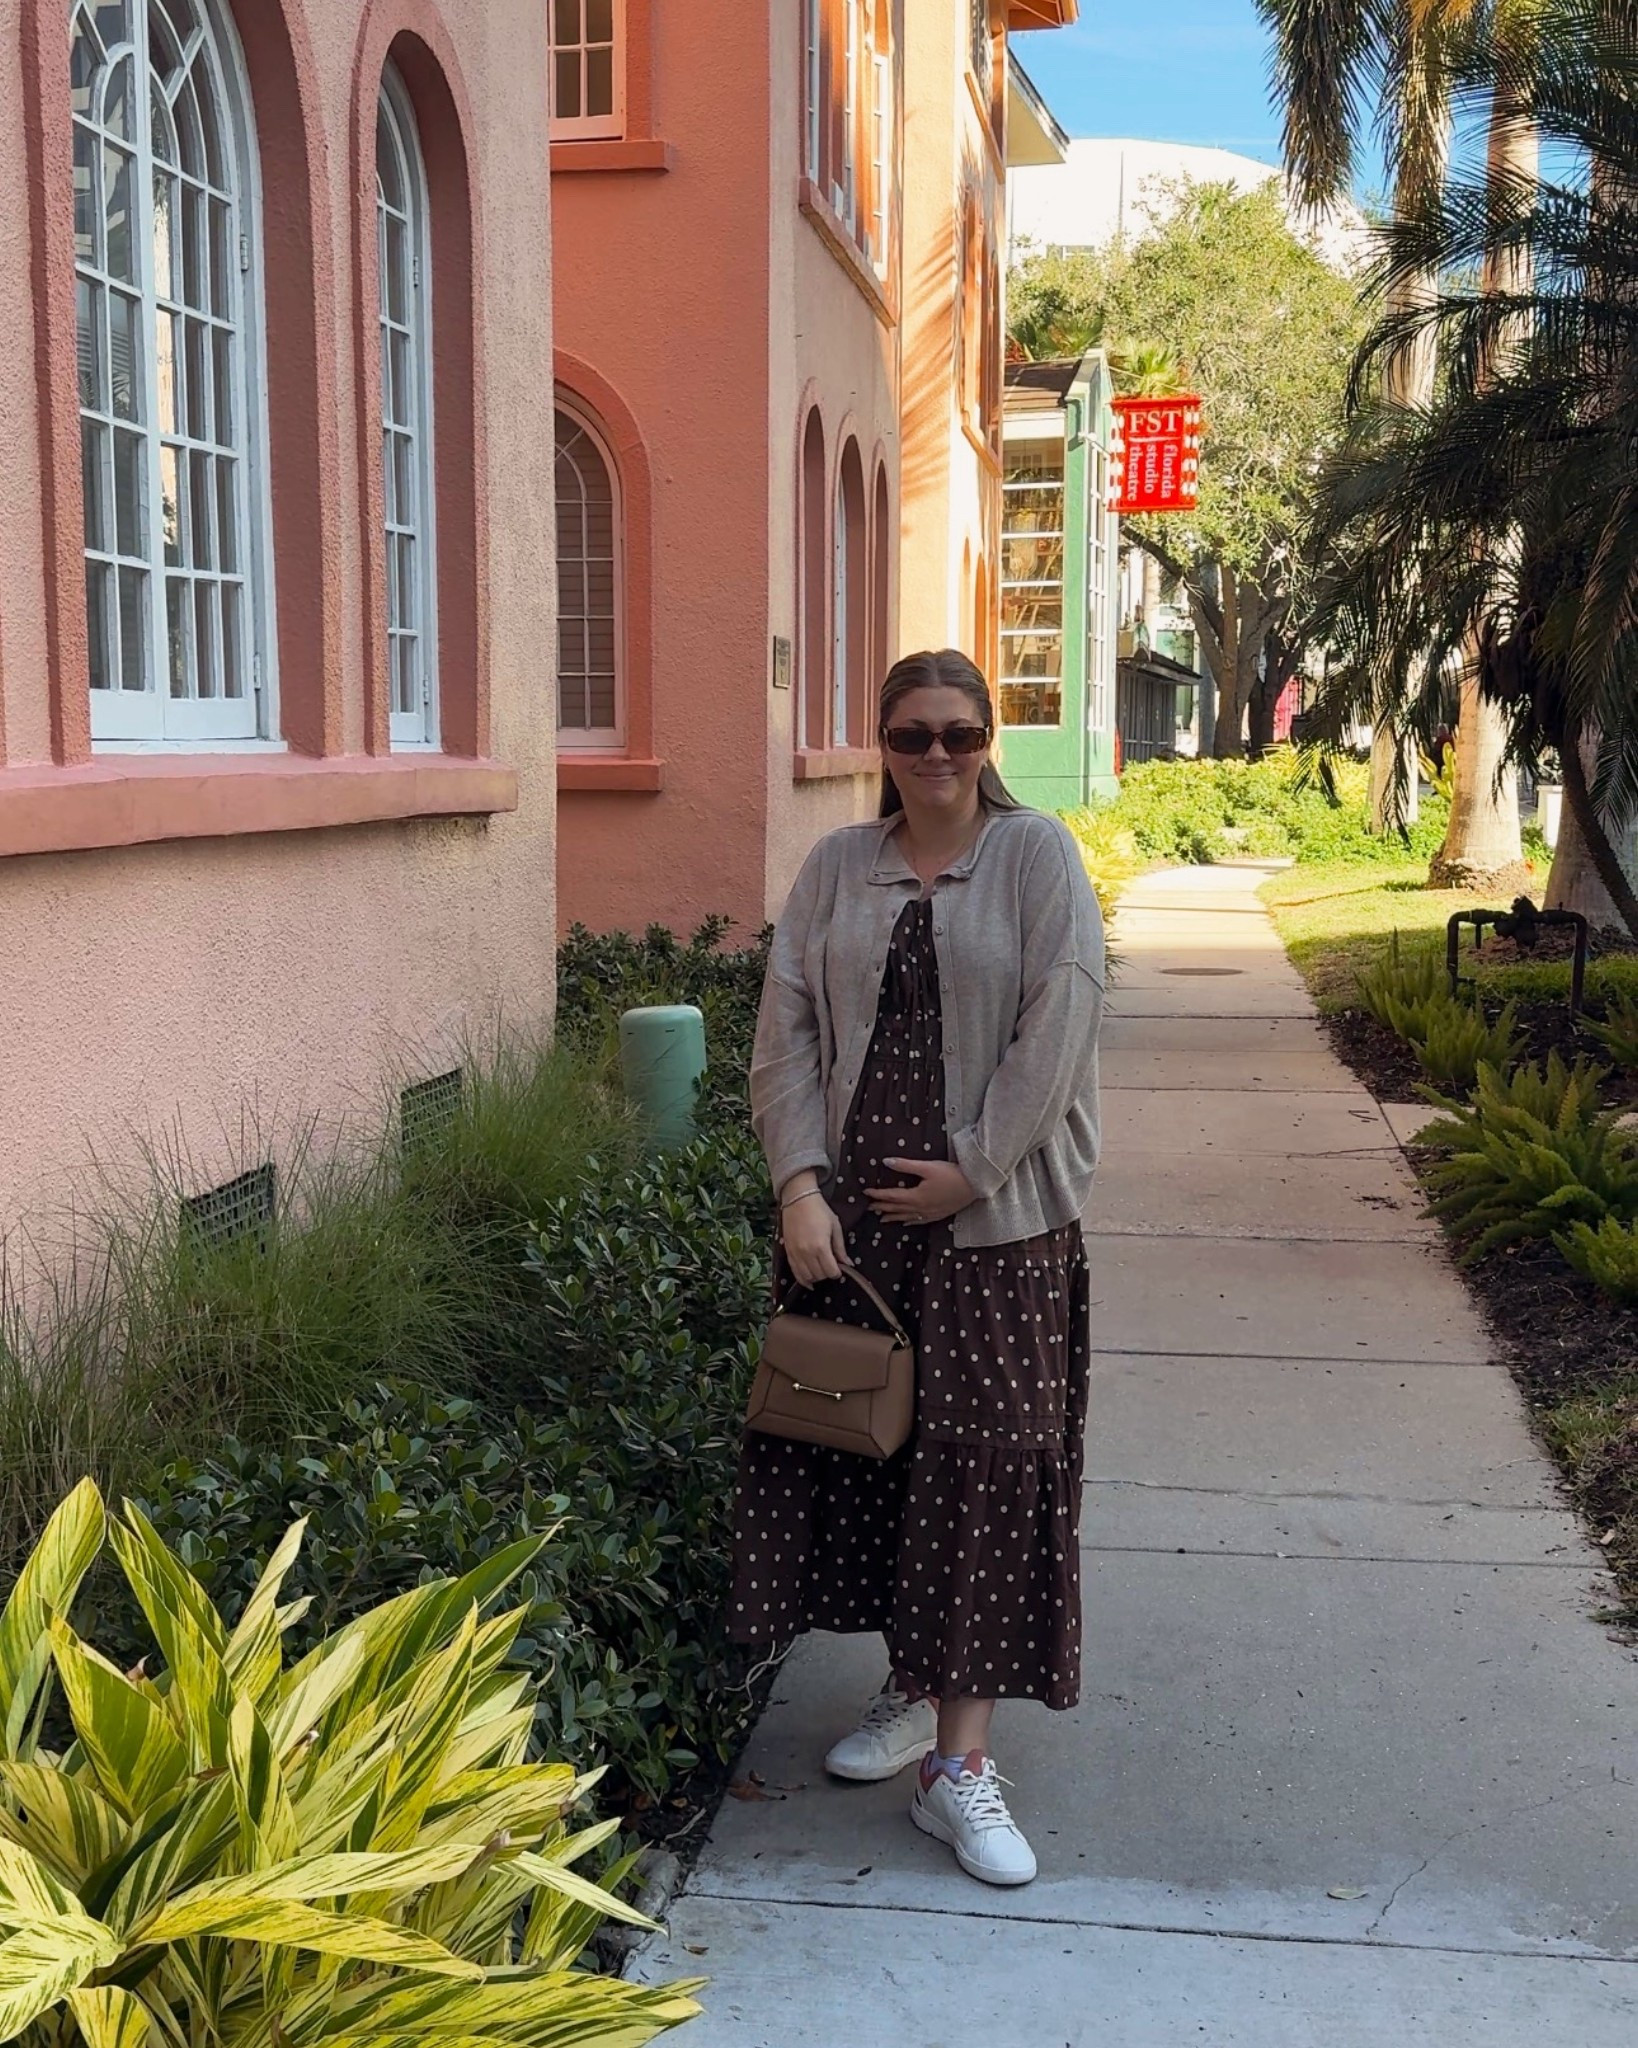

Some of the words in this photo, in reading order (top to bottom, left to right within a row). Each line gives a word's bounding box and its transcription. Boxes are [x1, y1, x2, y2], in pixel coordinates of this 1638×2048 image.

[1129, 410, 1182, 433] FST
[1127, 446, 1143, 501] theatre
[1144, 444, 1159, 494] studio
[1161, 444, 1178, 499] florida
